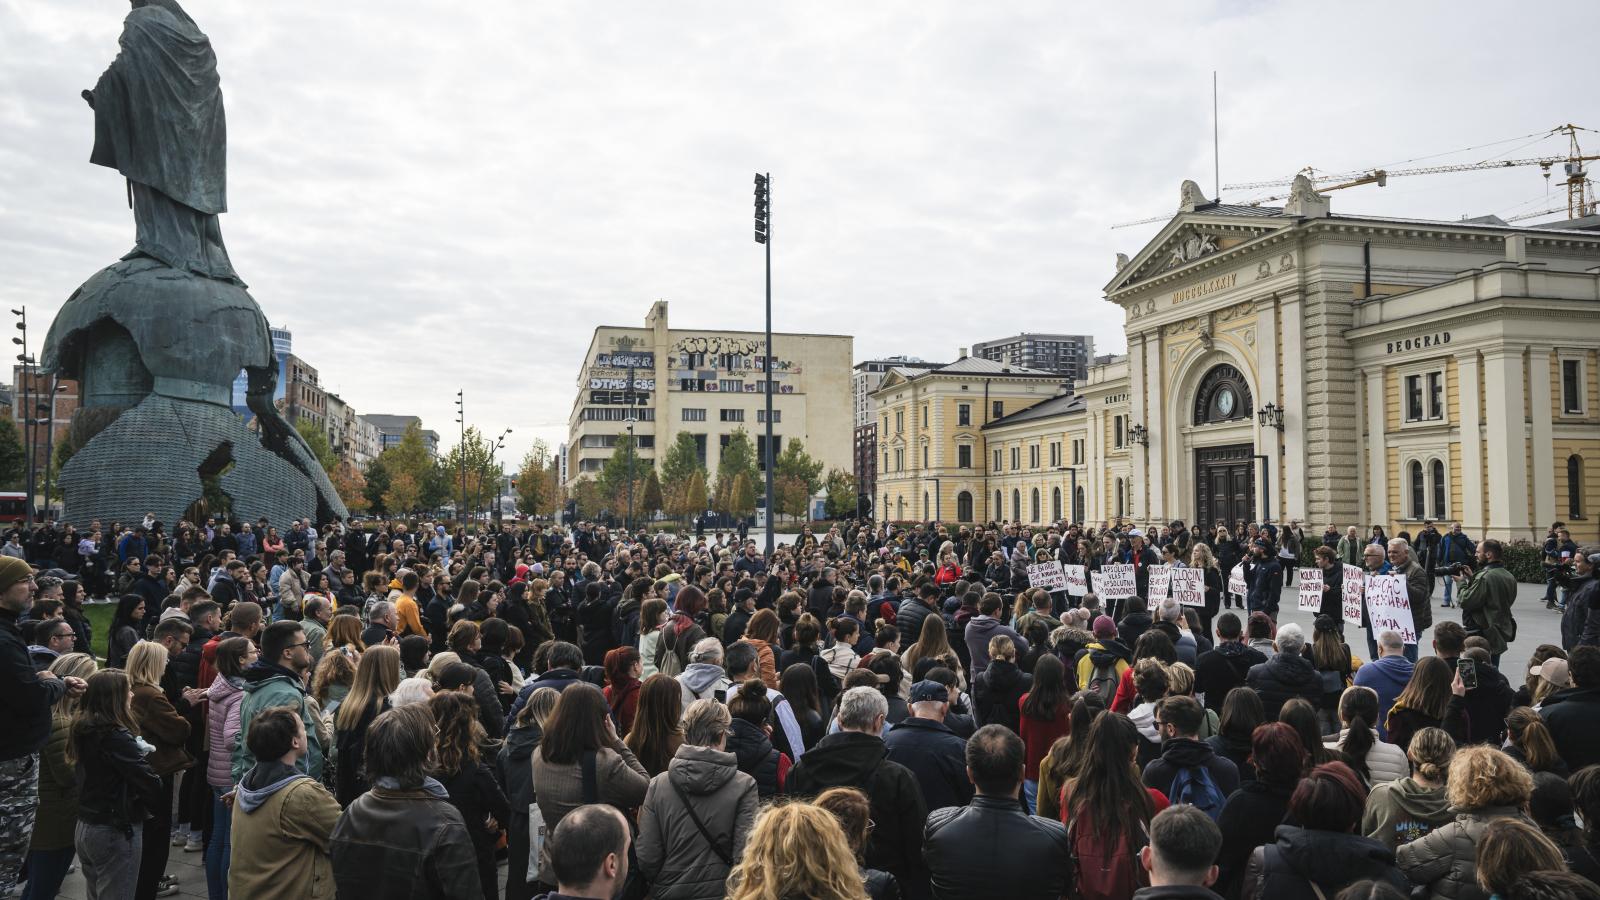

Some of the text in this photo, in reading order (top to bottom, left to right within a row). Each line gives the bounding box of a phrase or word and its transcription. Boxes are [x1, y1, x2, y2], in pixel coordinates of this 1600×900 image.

[1172, 273, 1237, 304] MDCCCLXXXIV
[1387, 332, 1451, 354] BEOGRAD
[633, 379, 655, 391] CBS
[1175, 580, 1181, 590] A
[1186, 581, 1197, 591] NE
